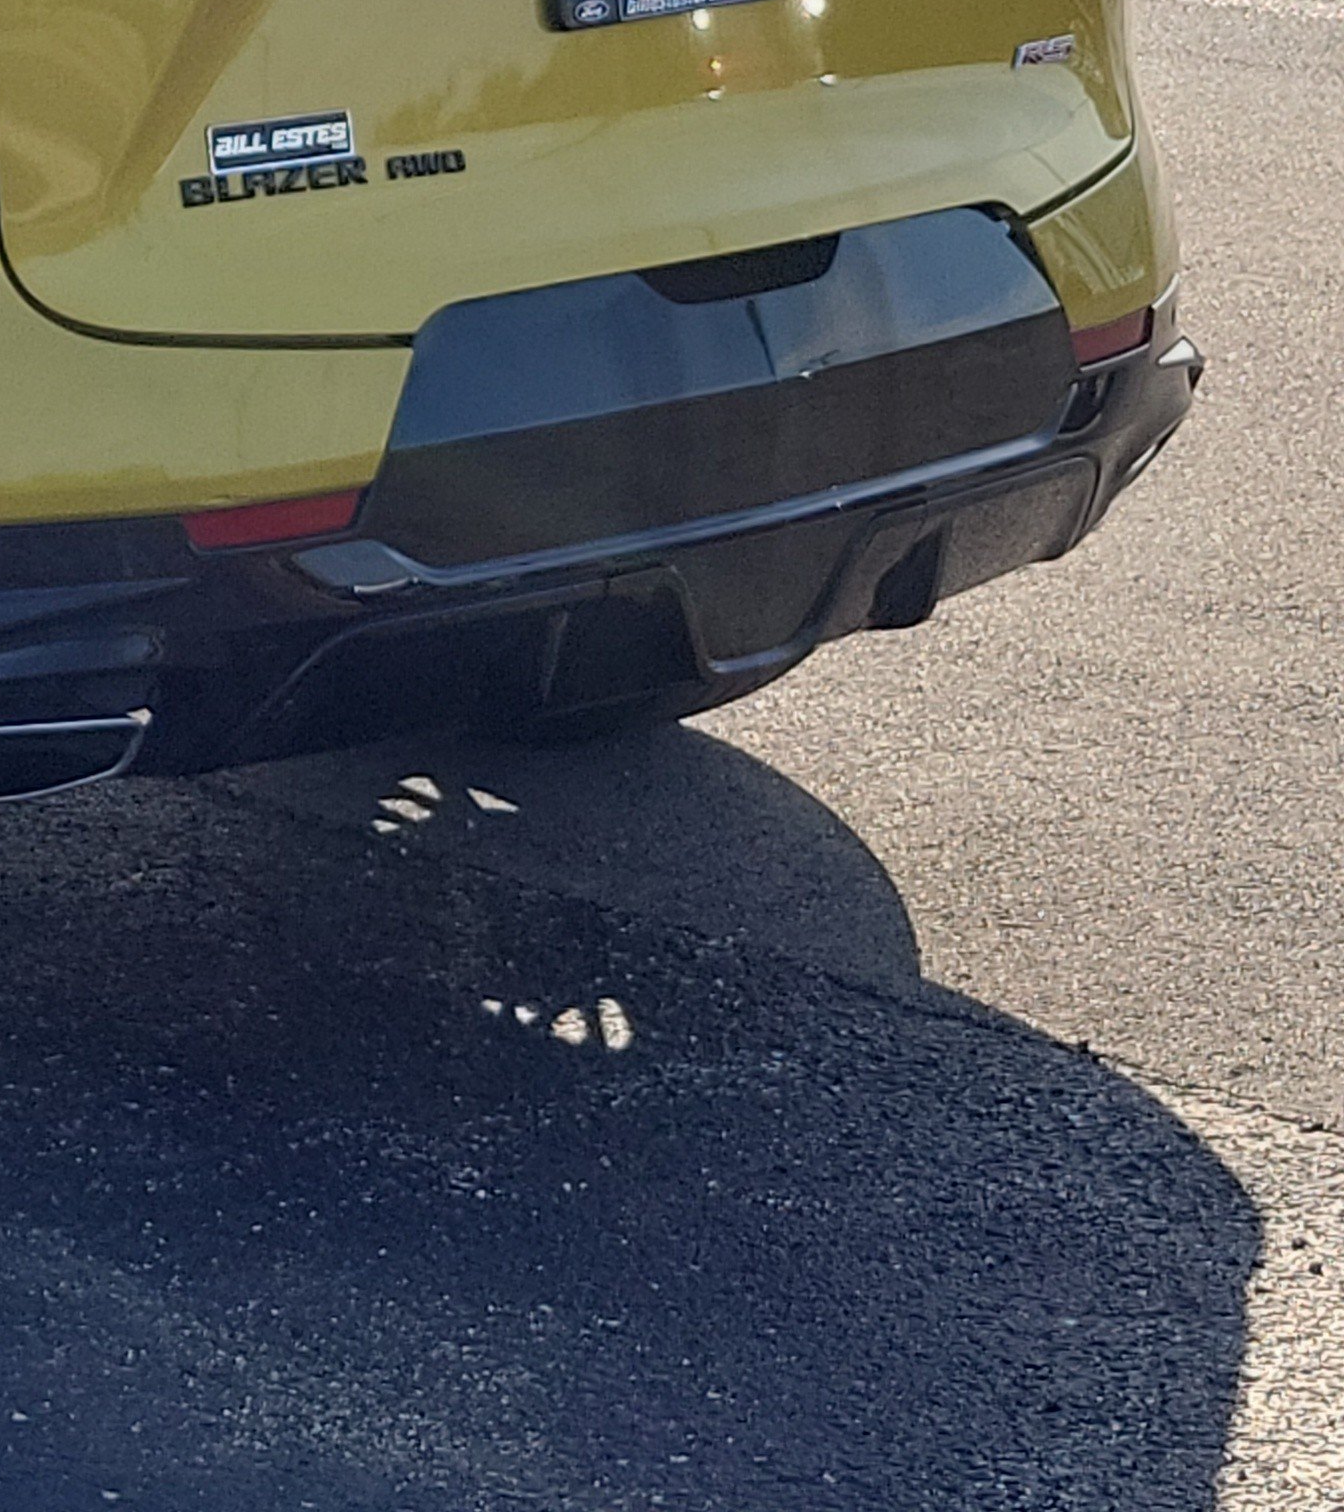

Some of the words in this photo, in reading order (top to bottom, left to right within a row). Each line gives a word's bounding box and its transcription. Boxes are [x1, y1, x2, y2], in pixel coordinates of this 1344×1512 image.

[214, 131, 268, 157] BILL
[271, 121, 348, 149] ESTES
[179, 156, 368, 209] BLAZER
[385, 149, 467, 180] AWD
